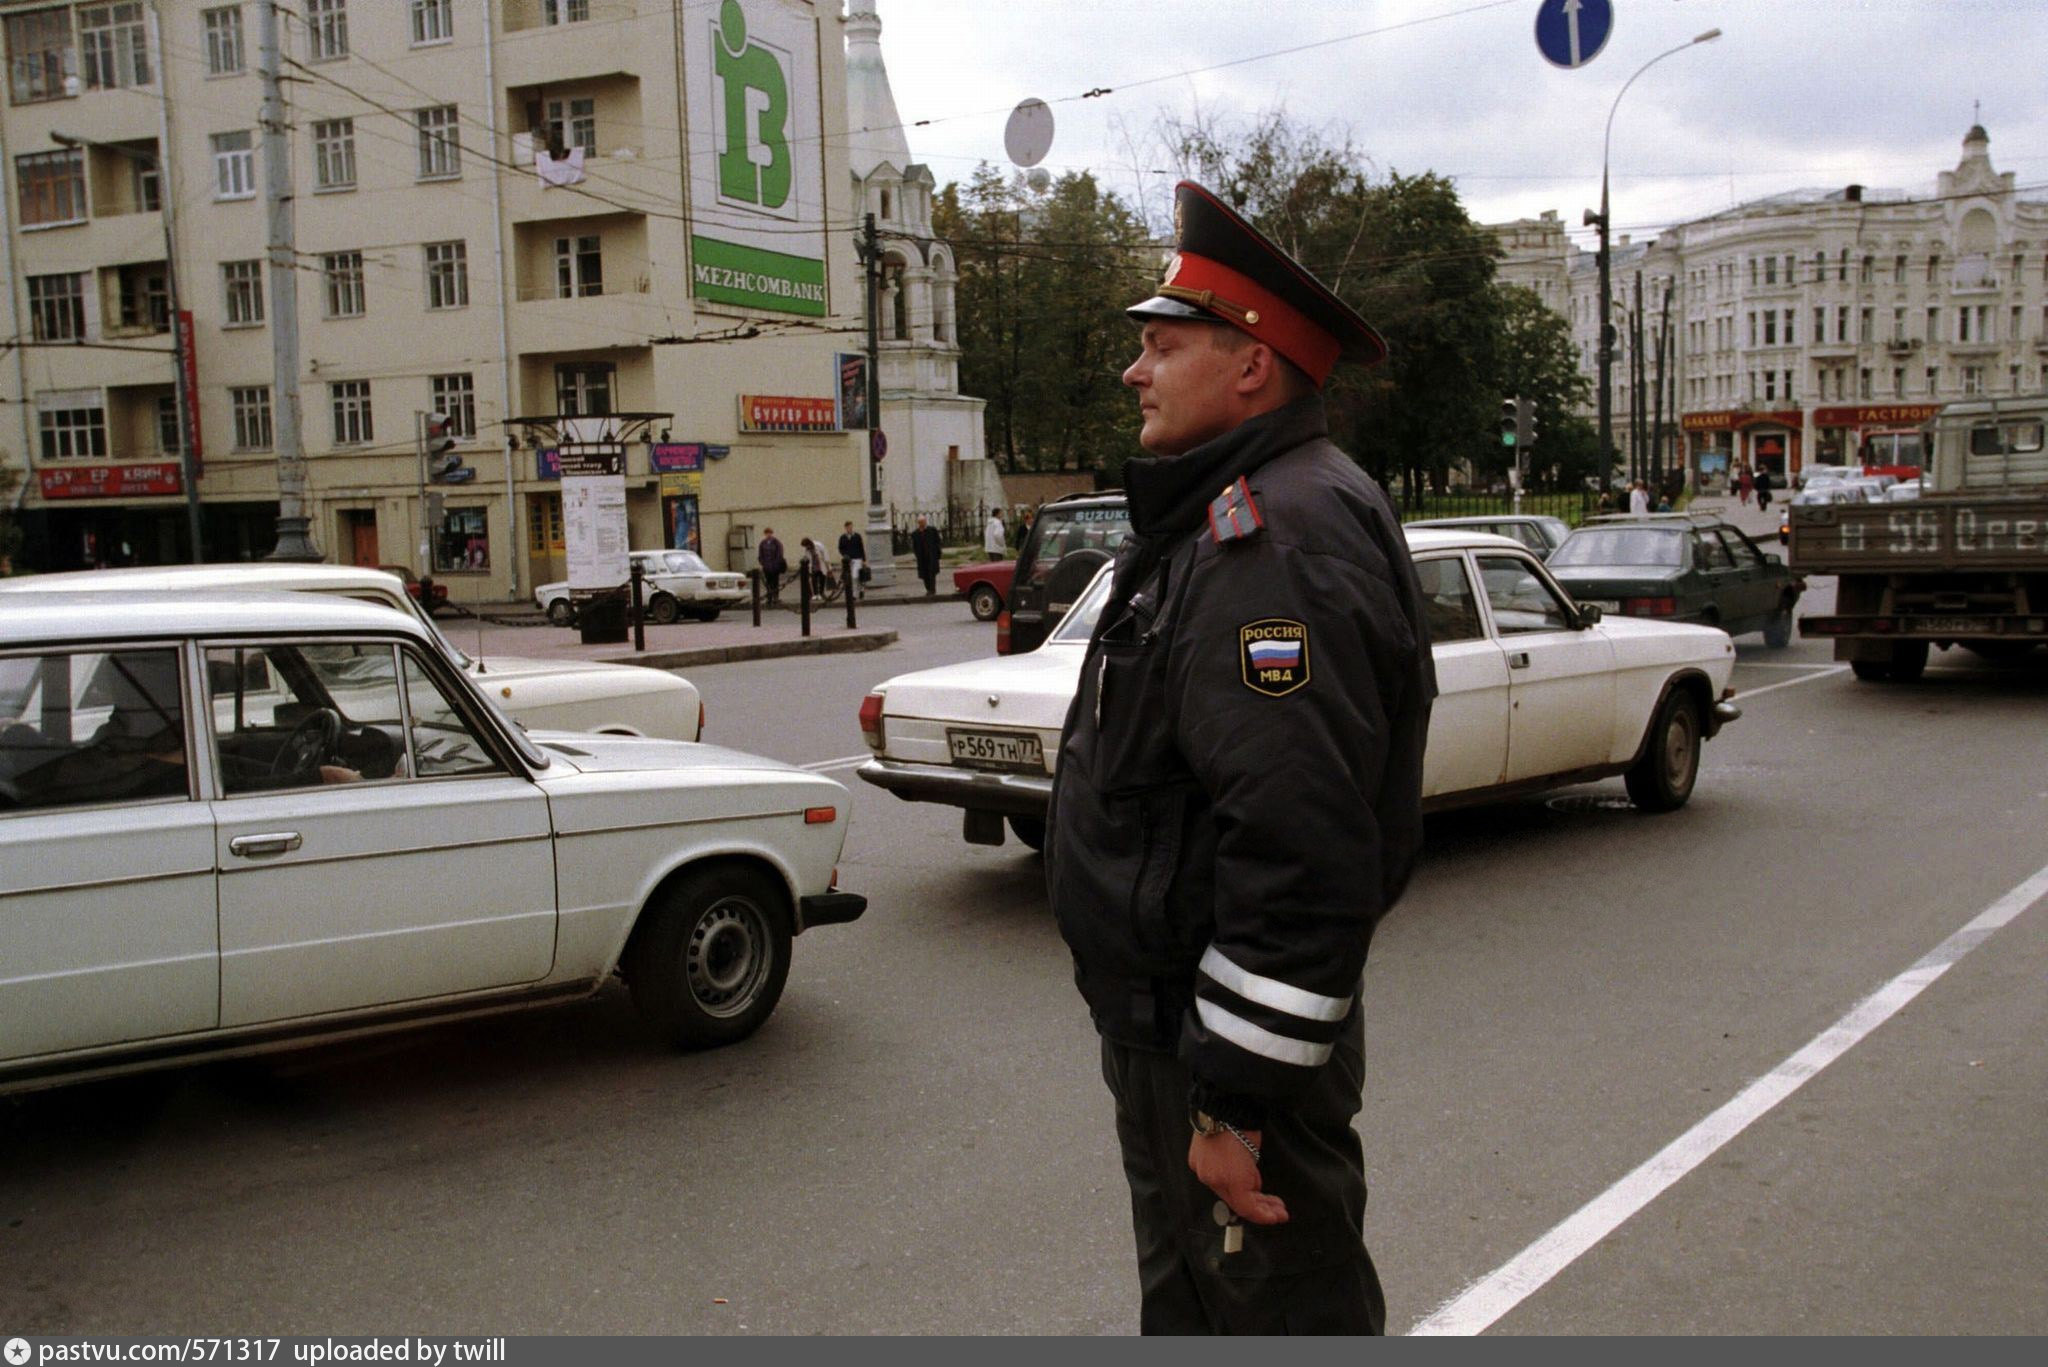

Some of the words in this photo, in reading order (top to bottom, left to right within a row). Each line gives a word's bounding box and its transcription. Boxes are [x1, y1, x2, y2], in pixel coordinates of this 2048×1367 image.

[695, 264, 823, 302] MEZHCOMBANK
[754, 406, 801, 422] БУРГЕР
[1244, 626, 1303, 641] РОССИЯ
[1260, 669, 1293, 683] МВД
